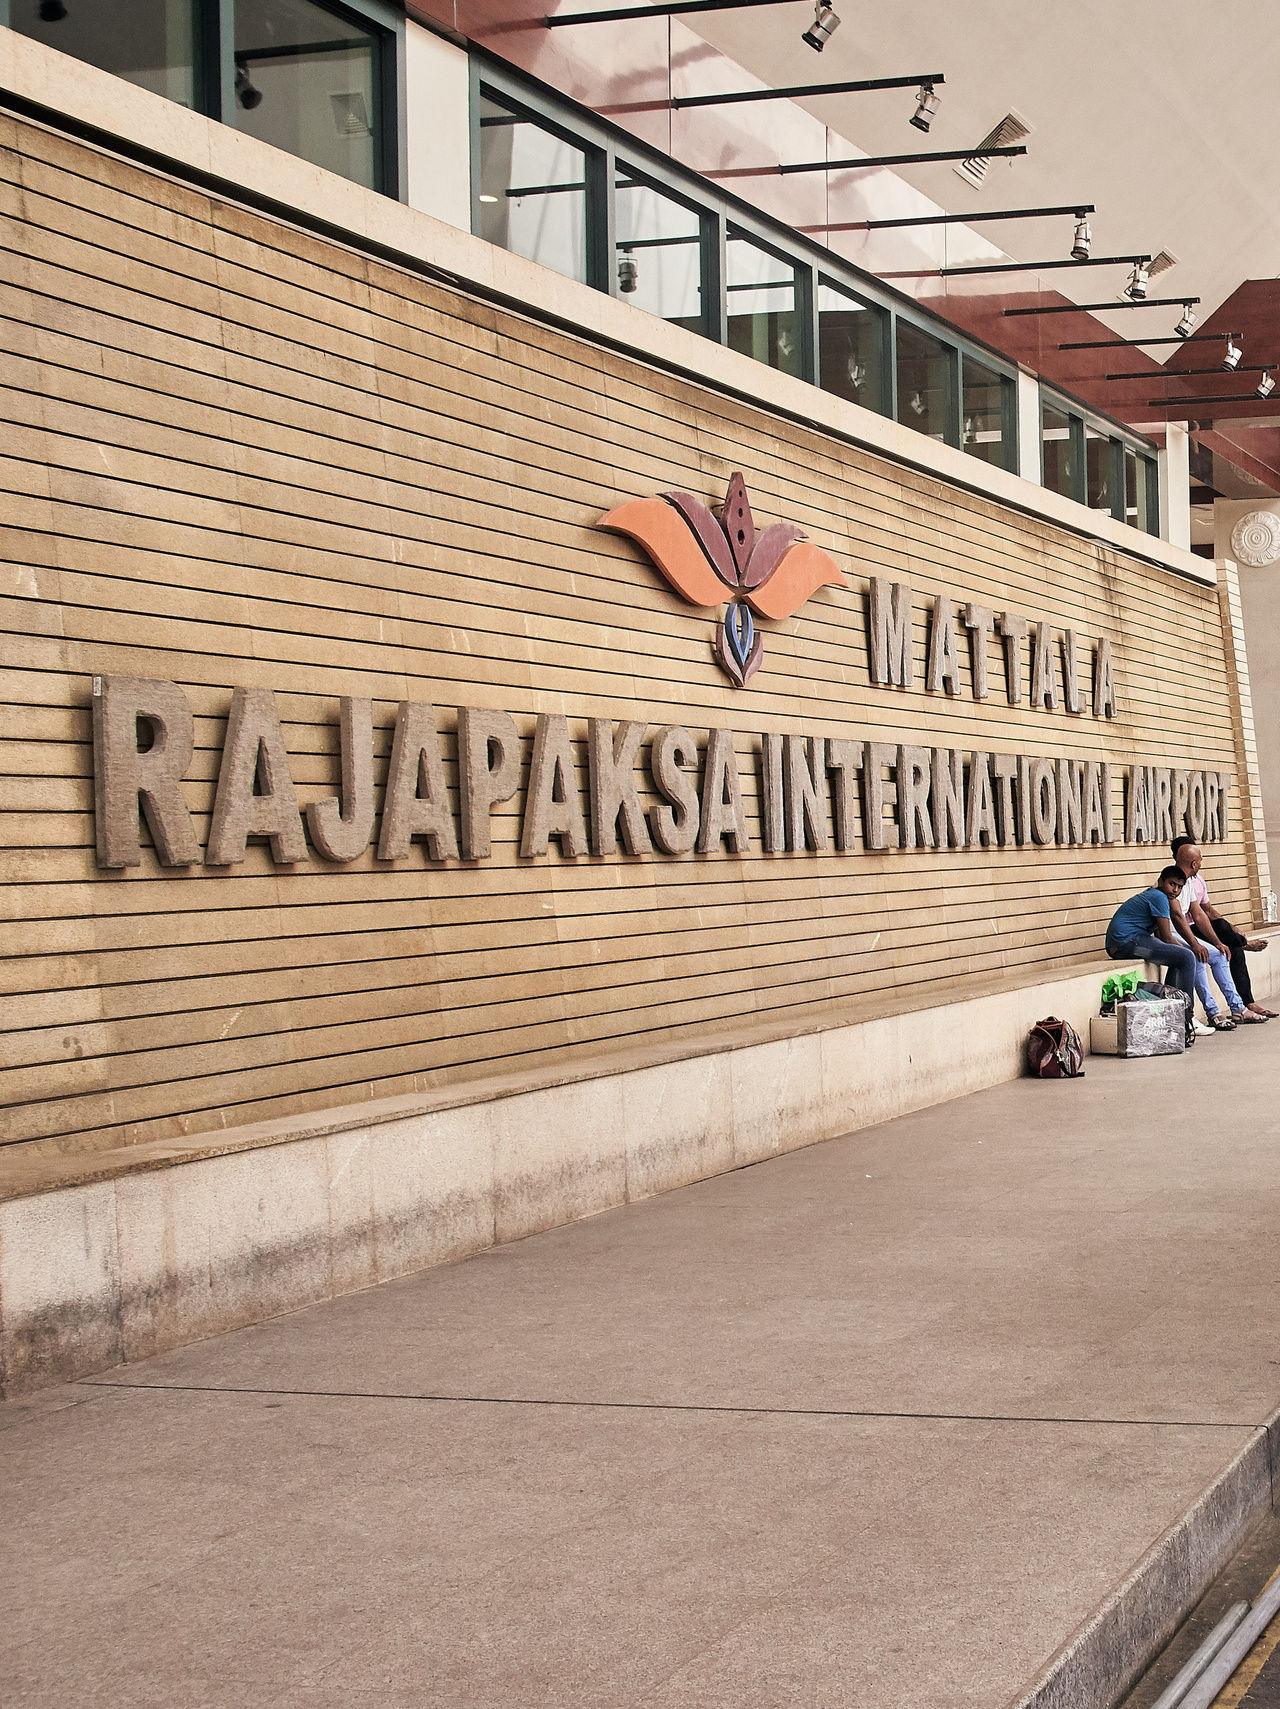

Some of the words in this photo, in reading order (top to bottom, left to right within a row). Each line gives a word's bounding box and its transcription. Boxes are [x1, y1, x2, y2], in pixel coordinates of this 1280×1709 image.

[869, 577, 1118, 718] MATTALA
[93, 674, 750, 869] RAJAPAKSA
[762, 732, 1121, 852] INTERNATIONAL
[1128, 765, 1231, 842] AIRPORT
[1143, 1016, 1166, 1029] ARRI
